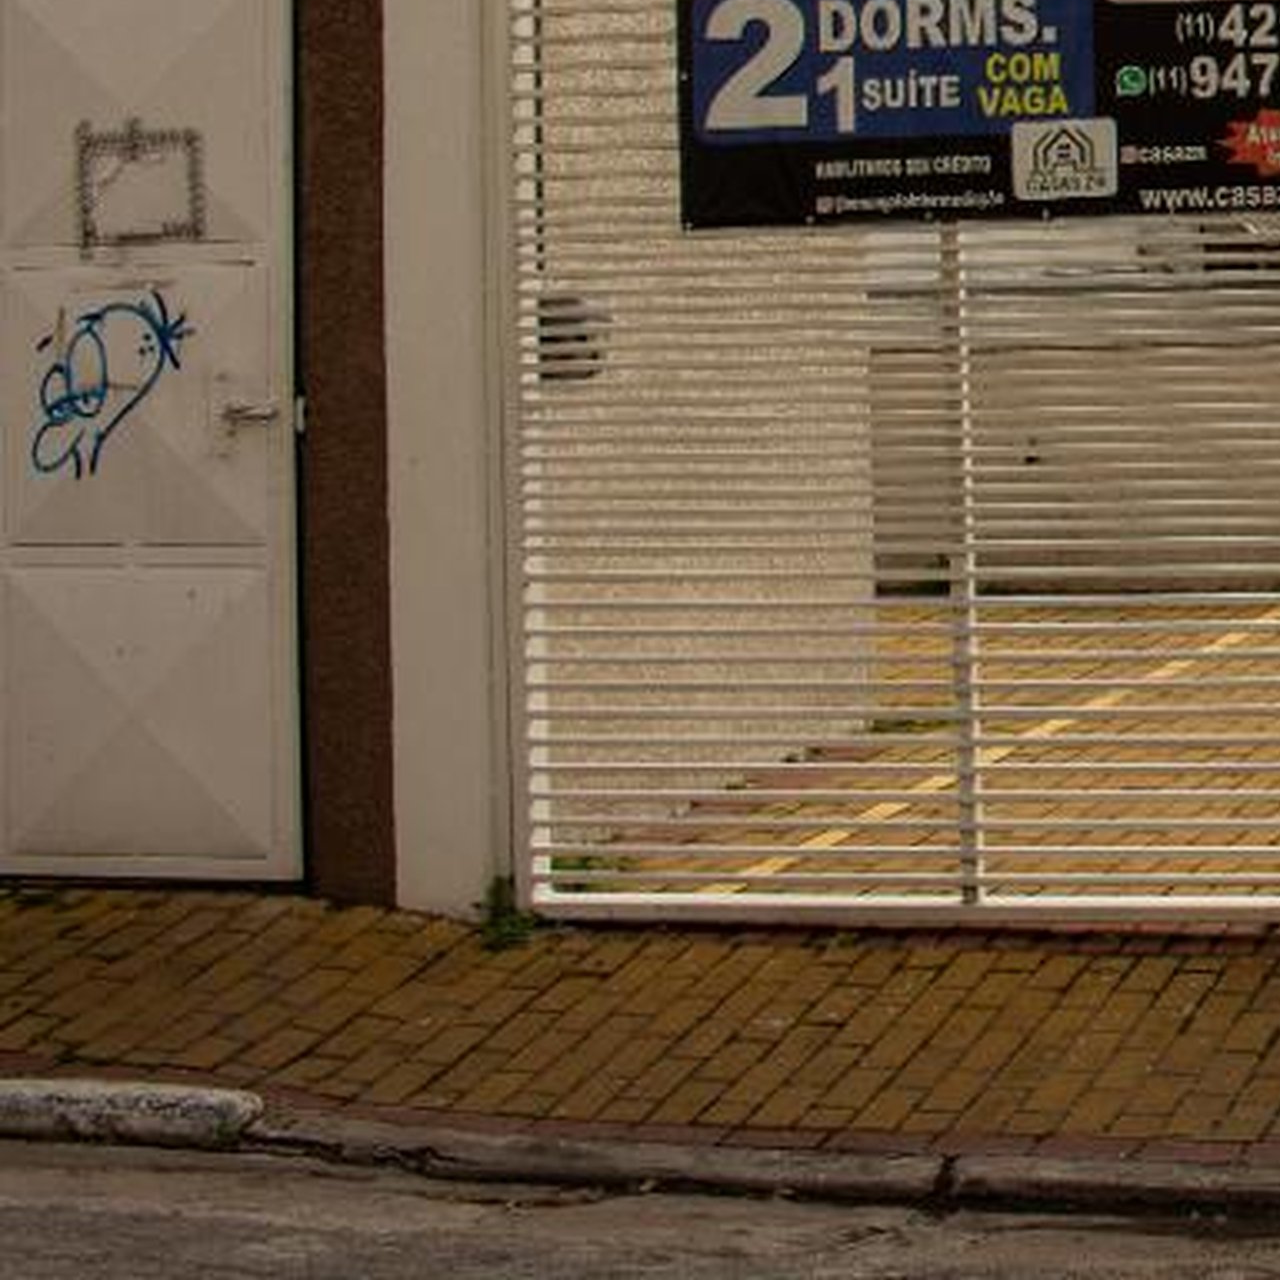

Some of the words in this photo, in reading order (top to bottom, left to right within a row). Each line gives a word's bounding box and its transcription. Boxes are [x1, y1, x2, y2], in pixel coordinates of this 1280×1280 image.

[984, 52, 1062, 84] COM
[816, 56, 856, 134] 1
[861, 69, 962, 111] SUÍTE
[976, 85, 1070, 118] VAGA
